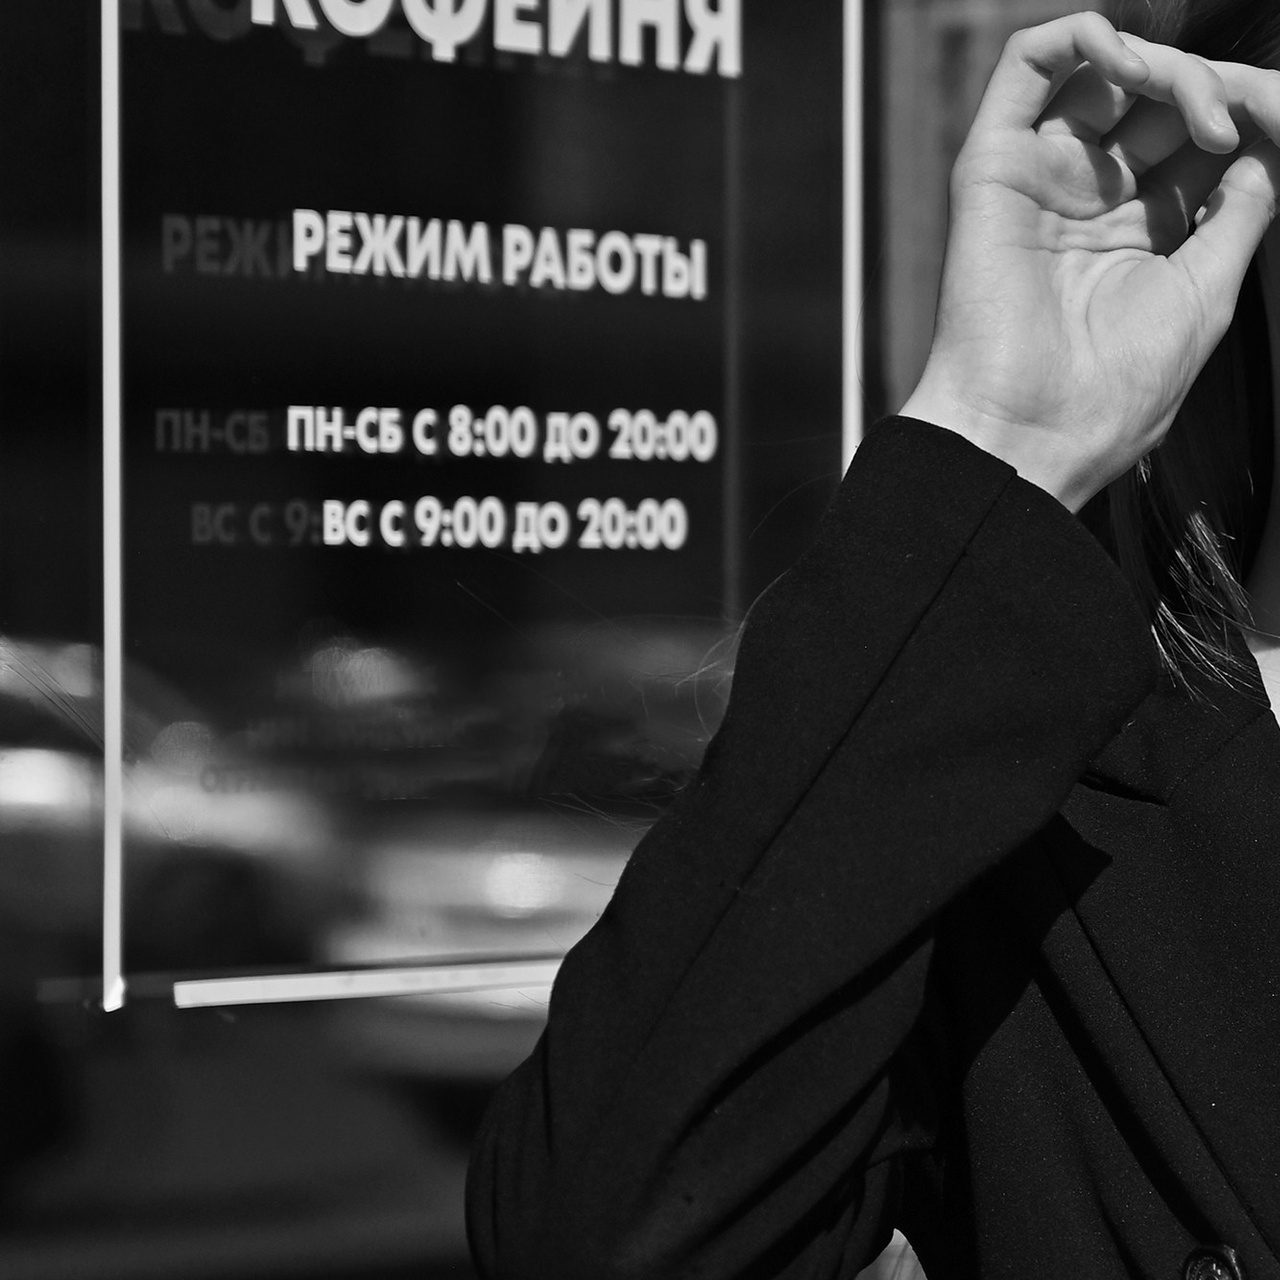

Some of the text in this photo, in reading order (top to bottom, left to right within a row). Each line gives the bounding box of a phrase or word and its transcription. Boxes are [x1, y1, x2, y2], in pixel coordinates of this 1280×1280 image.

[292, 208, 708, 301] РЕЖИМ РАБОТЫ
[287, 404, 719, 464] ПН-СБ С 8:00 ДО 20:00
[322, 499, 371, 547] ВС
[379, 499, 406, 547] С
[414, 495, 507, 549] 9:00
[512, 501, 570, 554] ДО
[577, 497, 688, 550] 20:00
